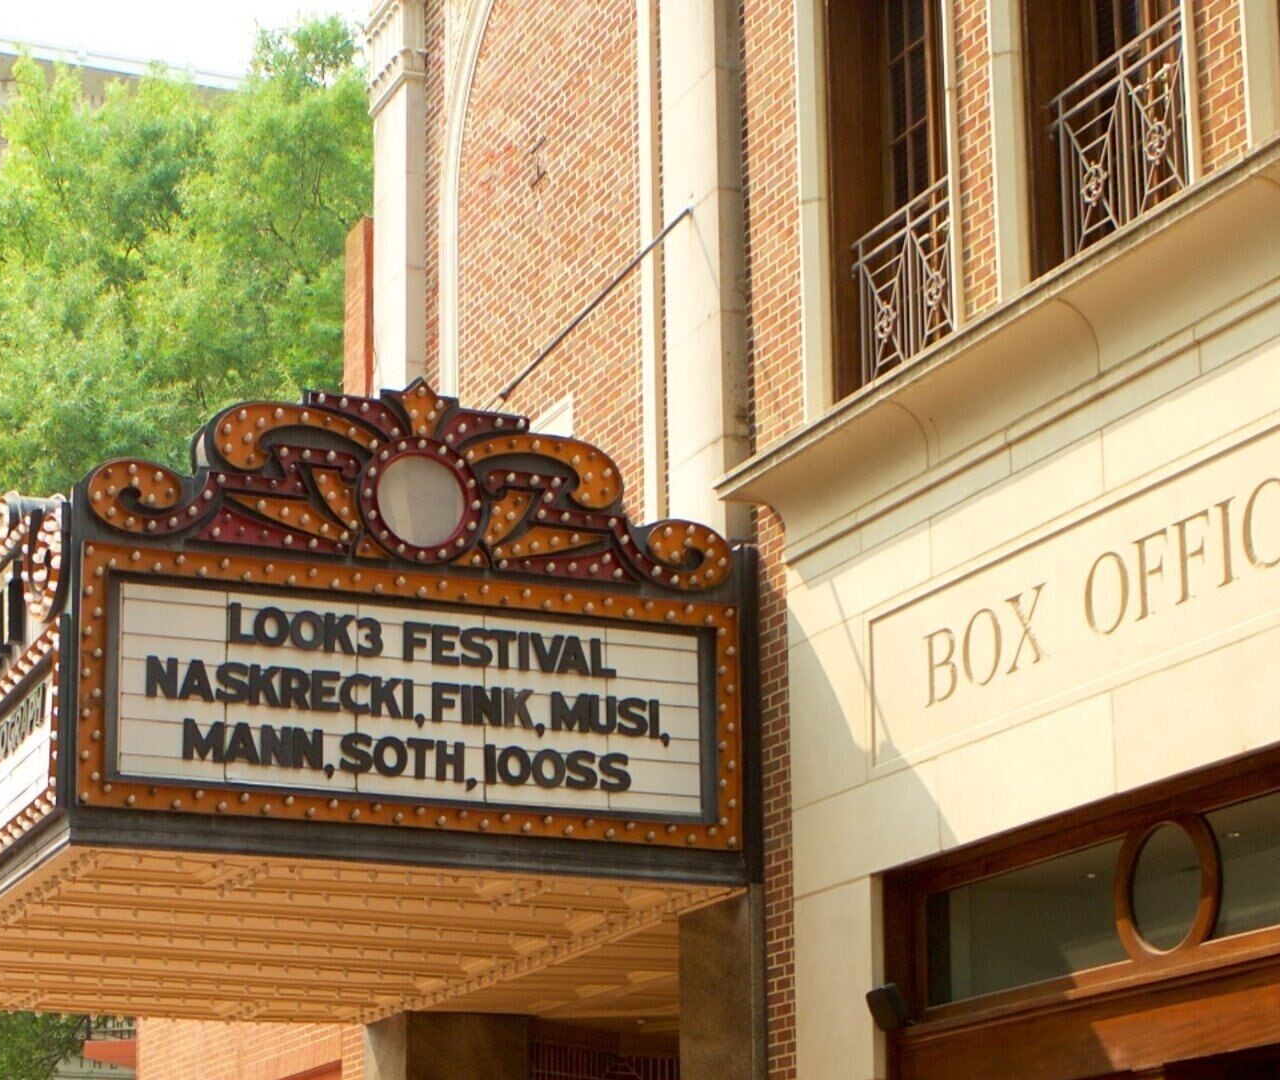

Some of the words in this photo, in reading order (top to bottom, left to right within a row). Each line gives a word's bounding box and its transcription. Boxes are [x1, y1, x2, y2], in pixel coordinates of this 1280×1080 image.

[229, 602, 383, 657] LOOK3
[403, 621, 617, 678] FESTIVAL
[923, 582, 1051, 708] BOX
